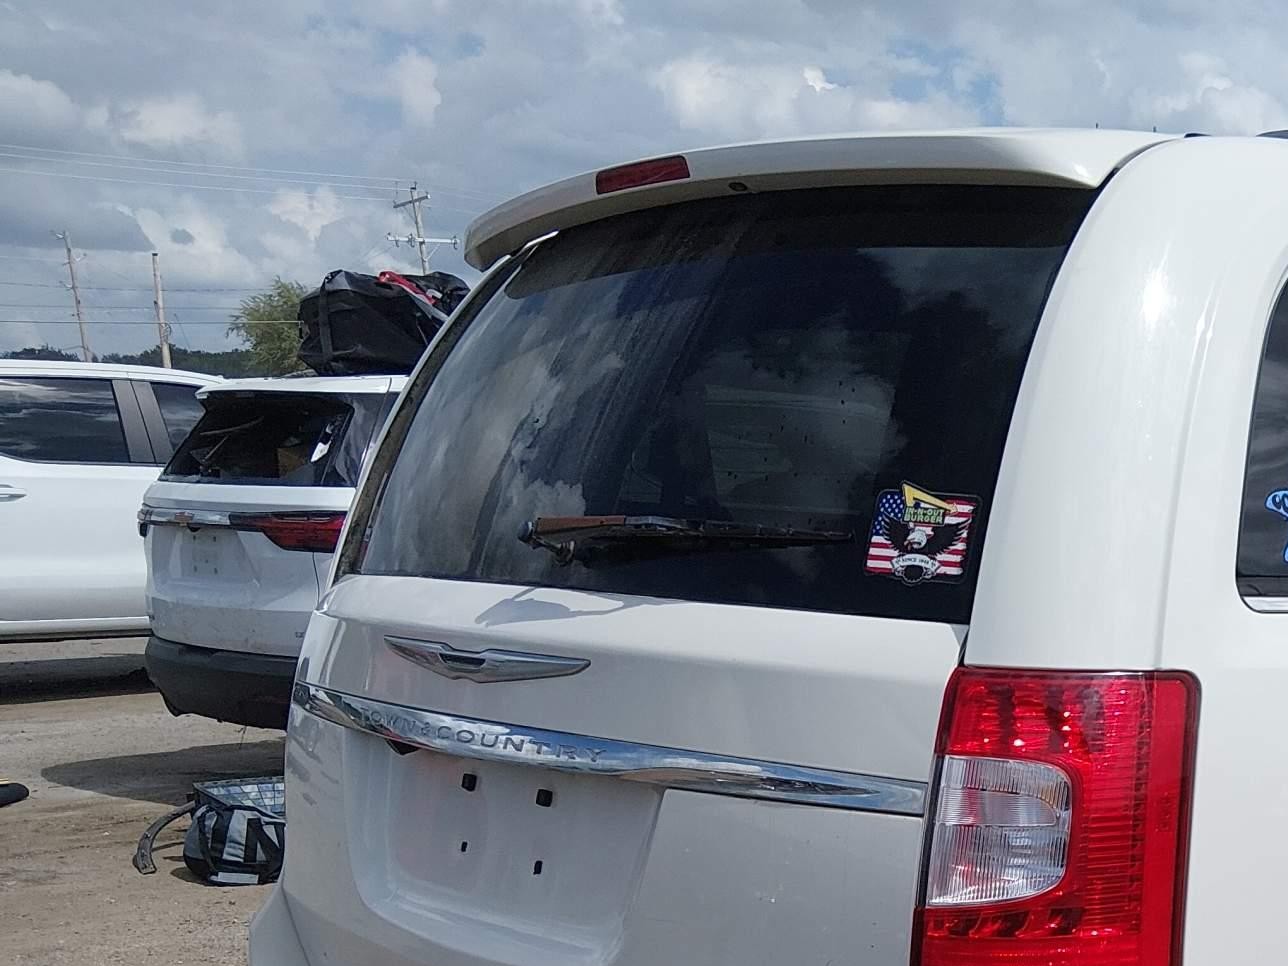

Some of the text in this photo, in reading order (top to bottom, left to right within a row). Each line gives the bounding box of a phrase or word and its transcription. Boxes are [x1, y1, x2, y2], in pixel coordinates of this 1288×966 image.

[905, 507, 944, 516] IN-N-OUT
[904, 513, 943, 523] BURGER
[359, 706, 607, 763] TOWN & COUNTRY
